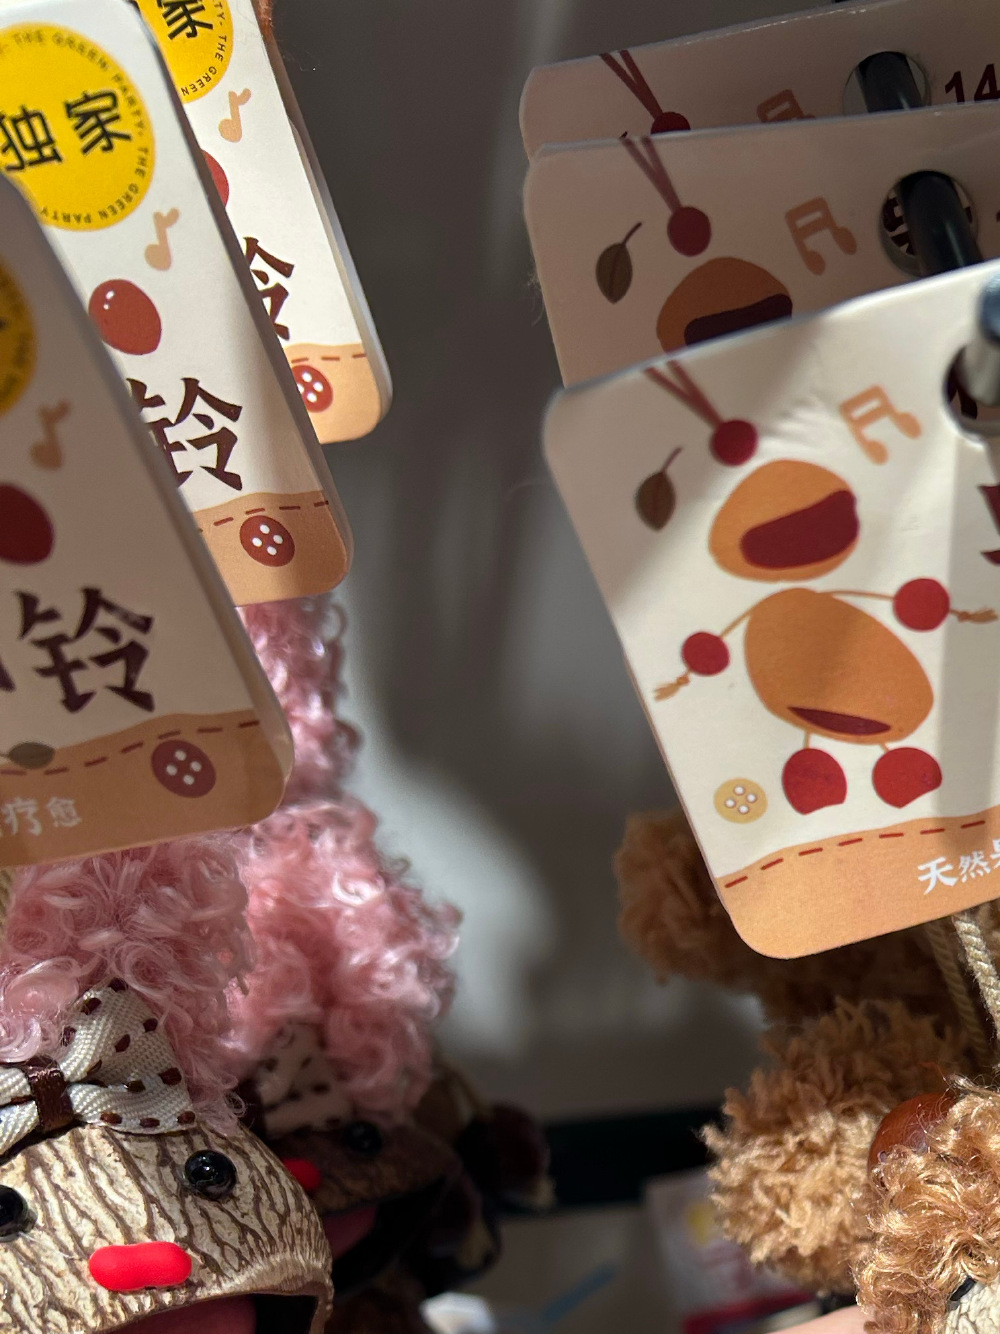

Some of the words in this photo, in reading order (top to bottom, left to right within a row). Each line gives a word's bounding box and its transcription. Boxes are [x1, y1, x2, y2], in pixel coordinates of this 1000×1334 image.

[214, 34, 228, 62] THE
[181, 66, 218, 97] GREEN
[0, 89, 135, 173] 独家
[0, 585, 156, 714] 铃
[0, 797, 82, 836] 疗愈
